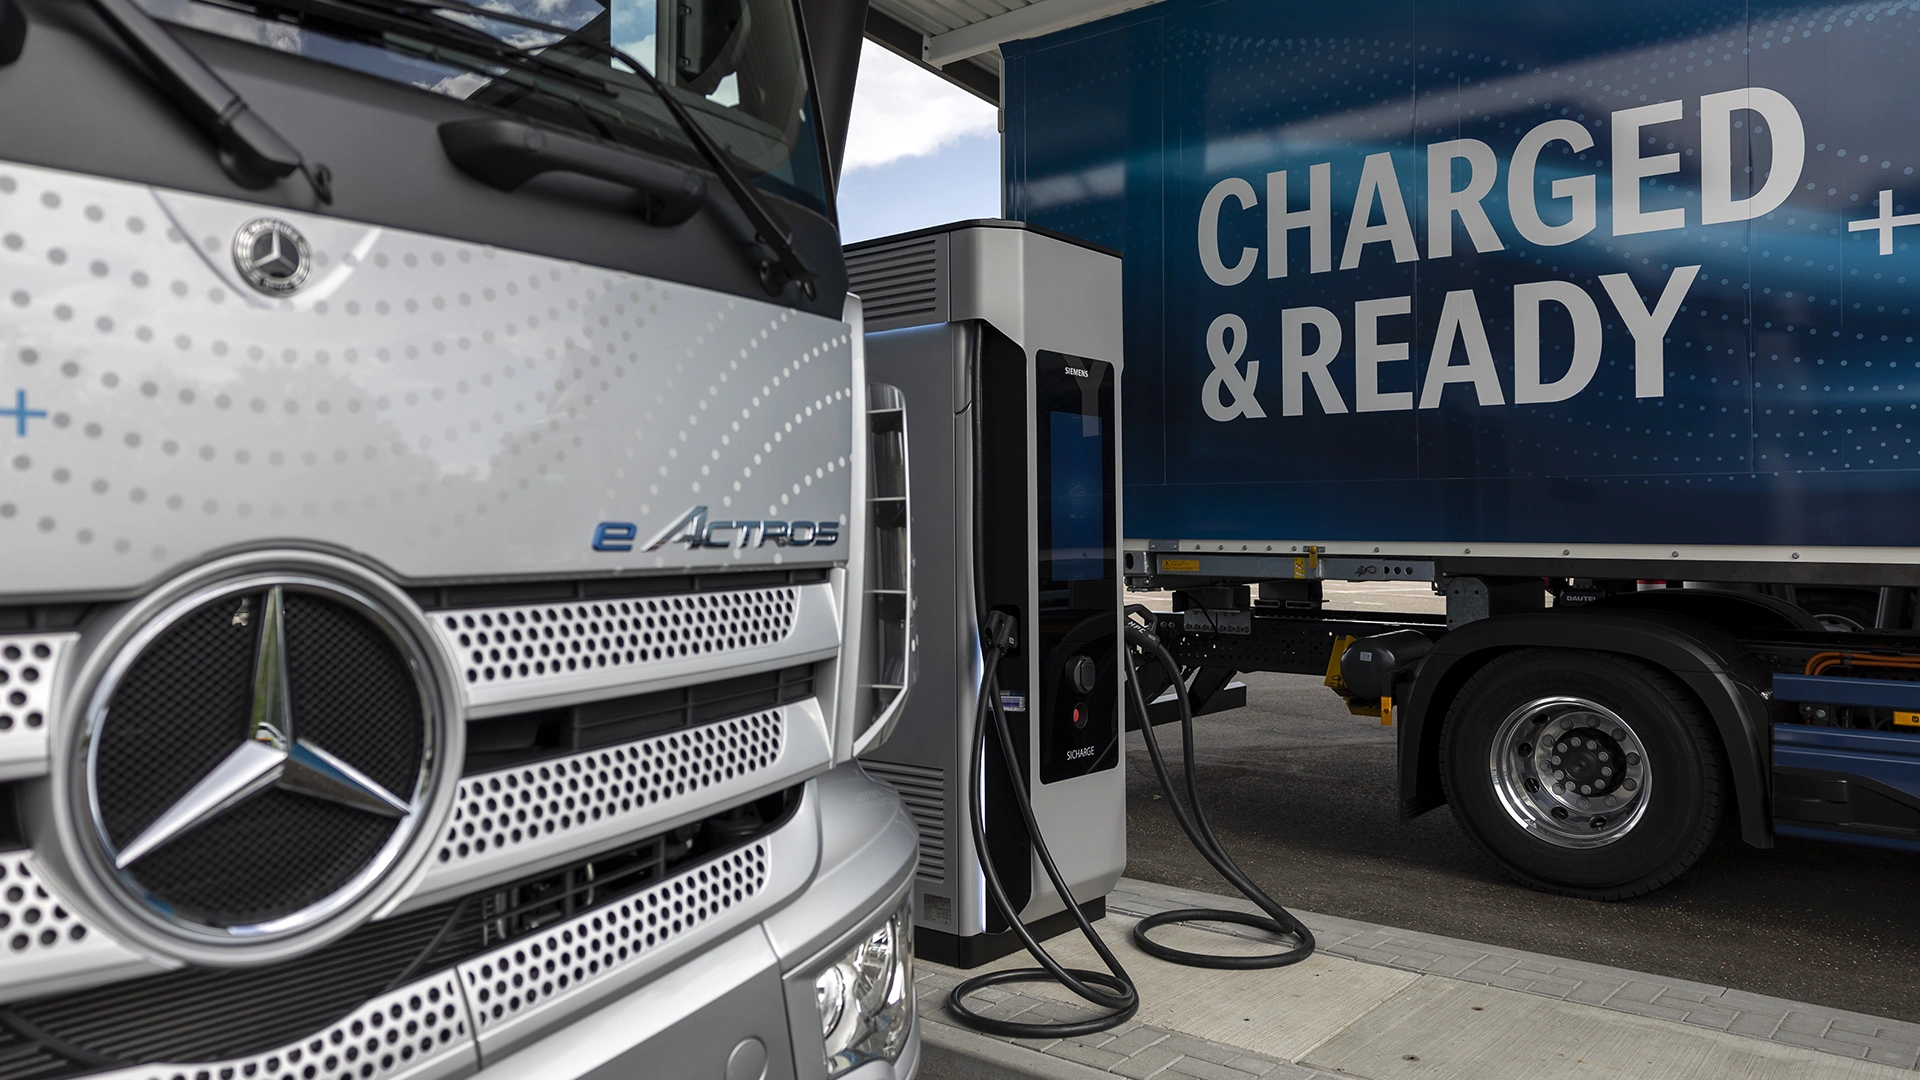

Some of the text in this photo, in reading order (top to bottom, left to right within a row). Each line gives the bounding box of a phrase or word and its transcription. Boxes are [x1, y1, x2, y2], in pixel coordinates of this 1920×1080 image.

[1198, 87, 1805, 286] CHARGED
[1064, 366, 1089, 378] SIEMENS
[1201, 265, 1702, 422] & READY
[1066, 745, 1095, 761] SICHARGE
